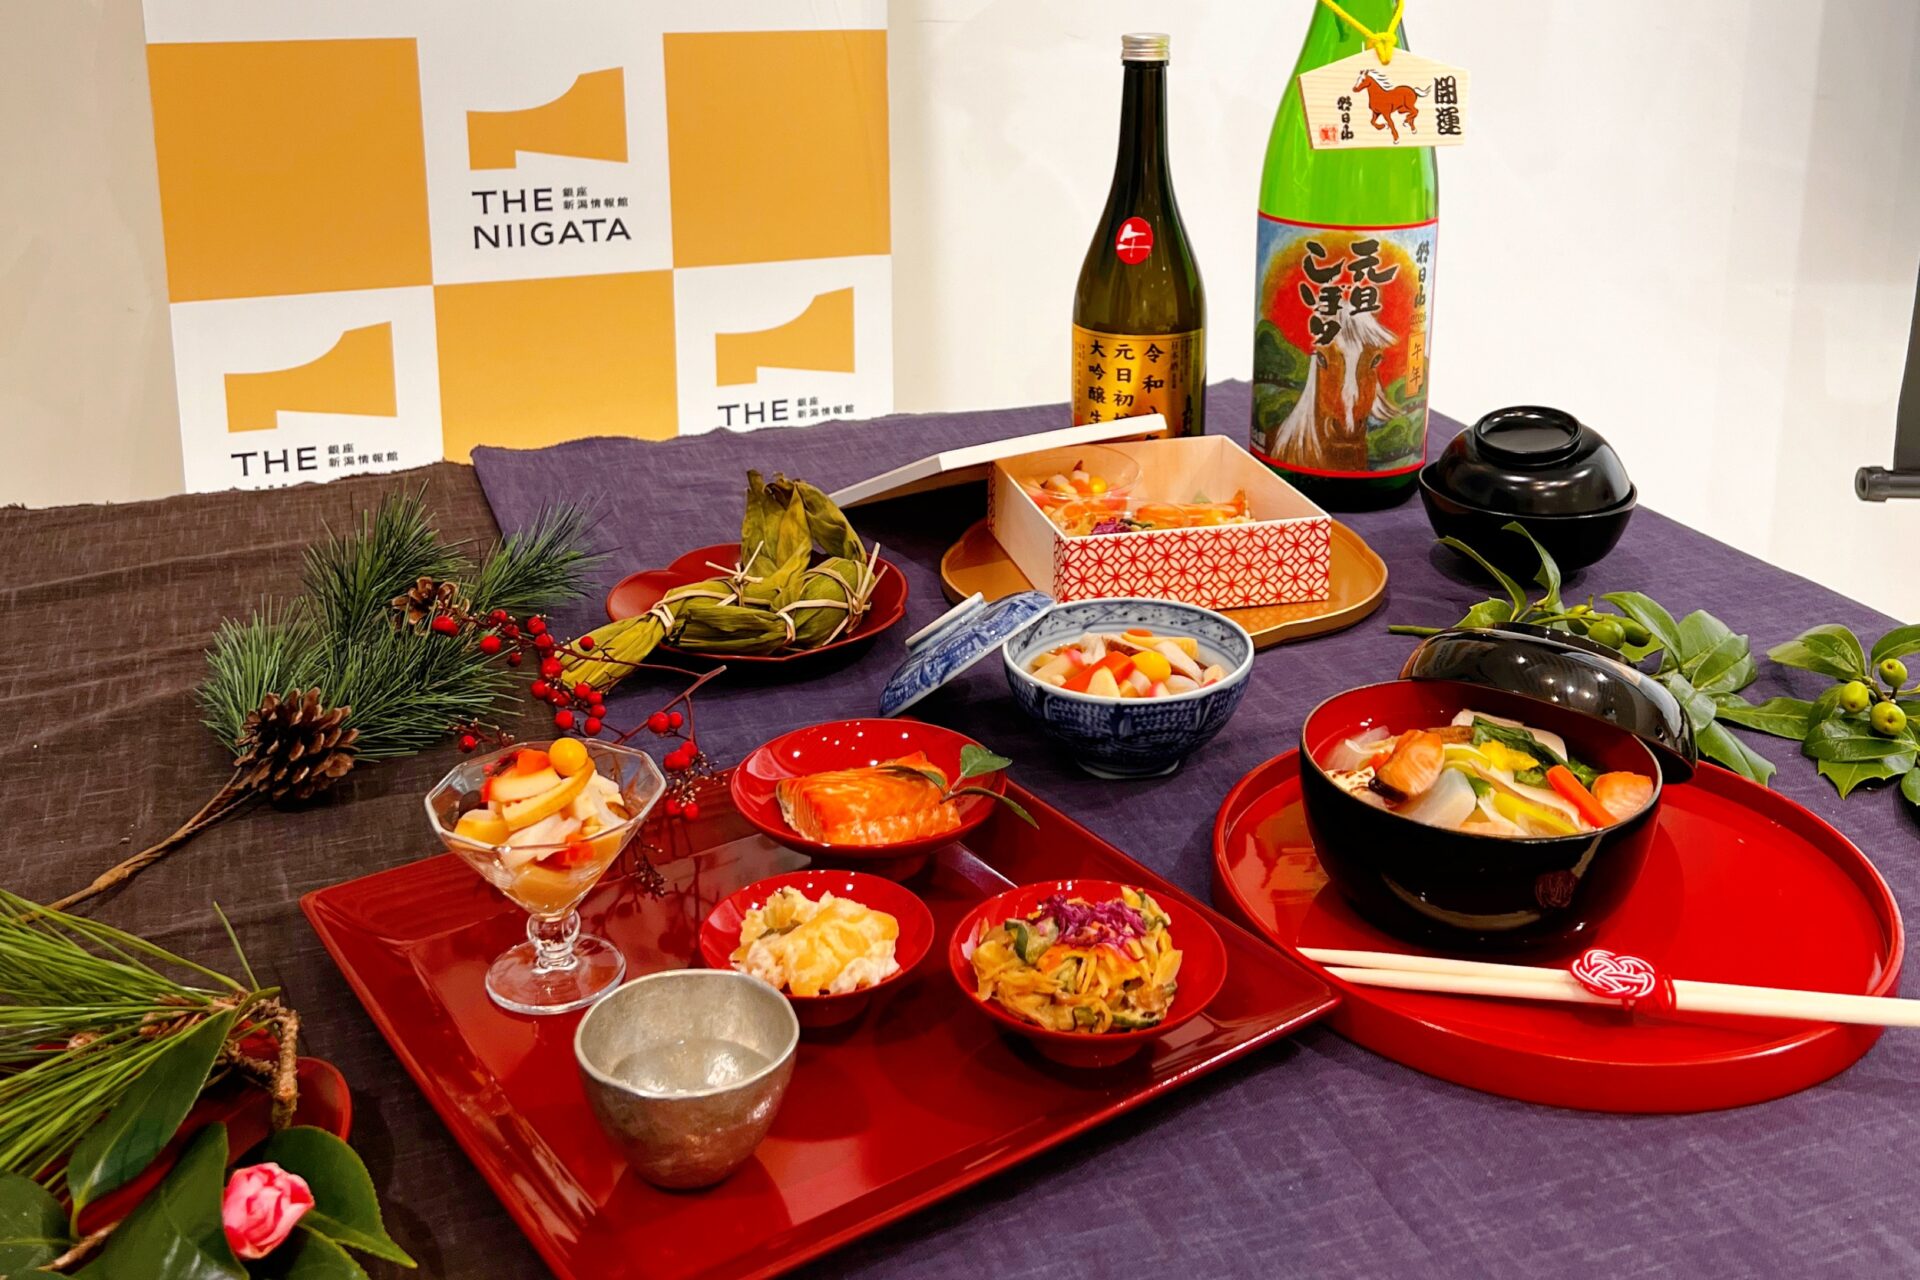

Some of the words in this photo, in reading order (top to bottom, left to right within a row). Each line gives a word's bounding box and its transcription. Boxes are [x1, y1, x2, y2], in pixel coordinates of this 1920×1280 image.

[472, 187, 553, 214] THE
[563, 186, 588, 198] 銀座
[563, 197, 629, 210] 新潟情報館
[474, 217, 631, 249] NIIGATA
[1347, 239, 1399, 316] 元旦
[718, 399, 789, 426] THE
[231, 446, 318, 476] THE
[328, 443, 354, 455] 銀座
[329, 451, 398, 468] 新潟情報館
